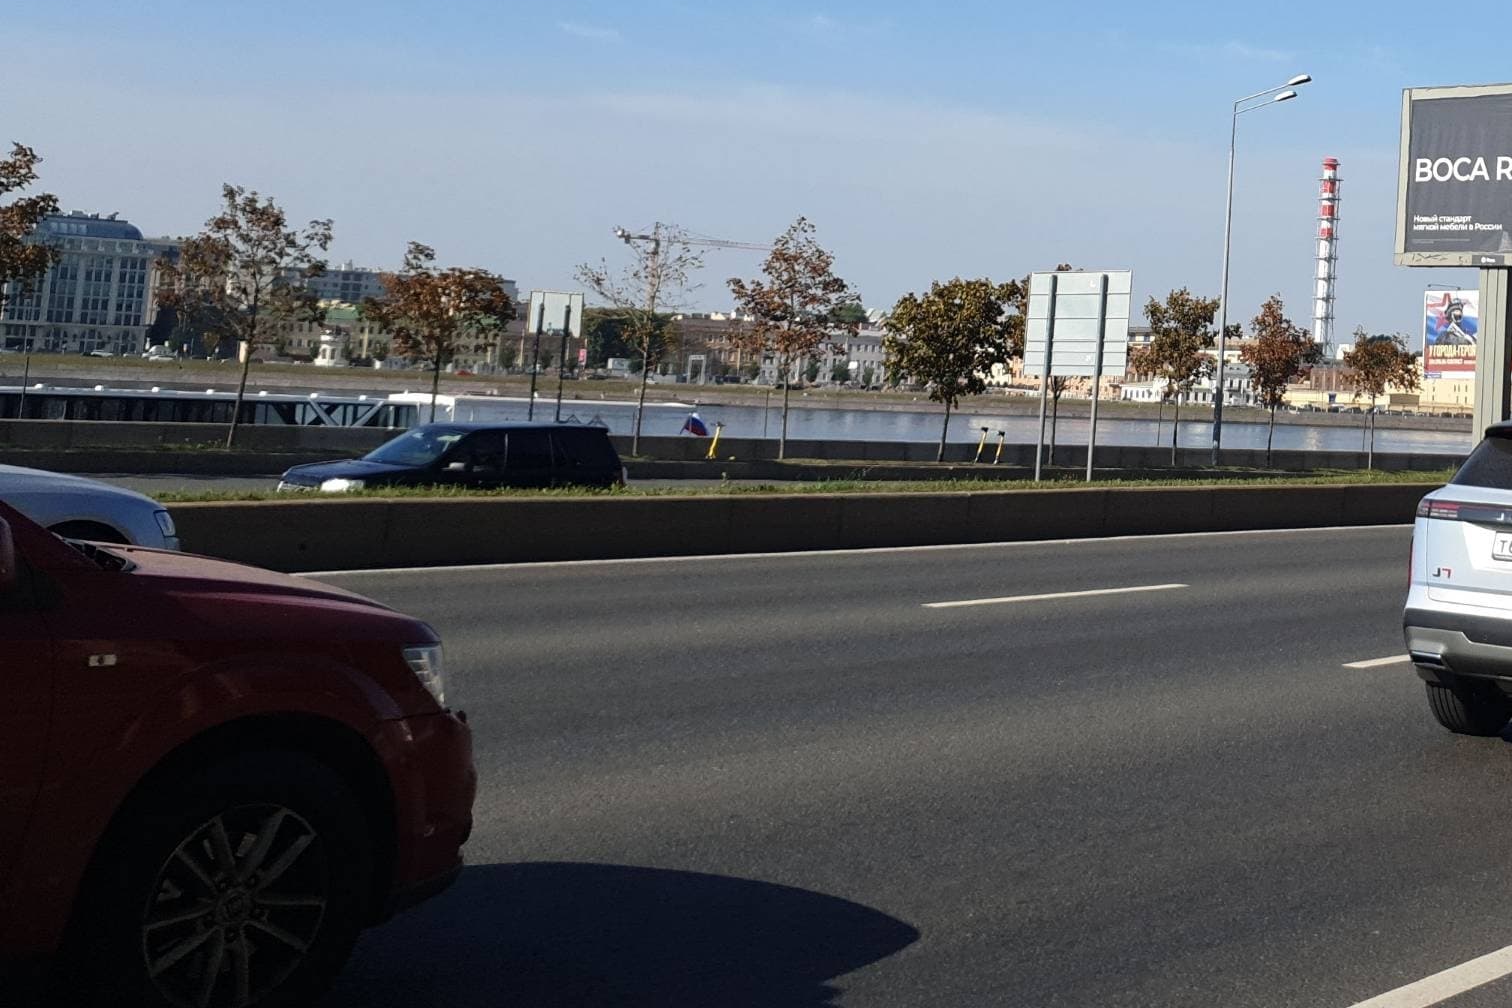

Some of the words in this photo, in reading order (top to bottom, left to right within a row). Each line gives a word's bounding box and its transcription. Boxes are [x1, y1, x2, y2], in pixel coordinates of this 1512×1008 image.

[1415, 156, 1490, 182] BOCA
[1413, 214, 1438, 223] Новый
[1438, 215, 1472, 224] стандарт
[1413, 223, 1439, 231] мягкой
[1440, 223, 1468, 231] мебели
[1474, 223, 1503, 231] России
[1432, 567, 1452, 579] J7
